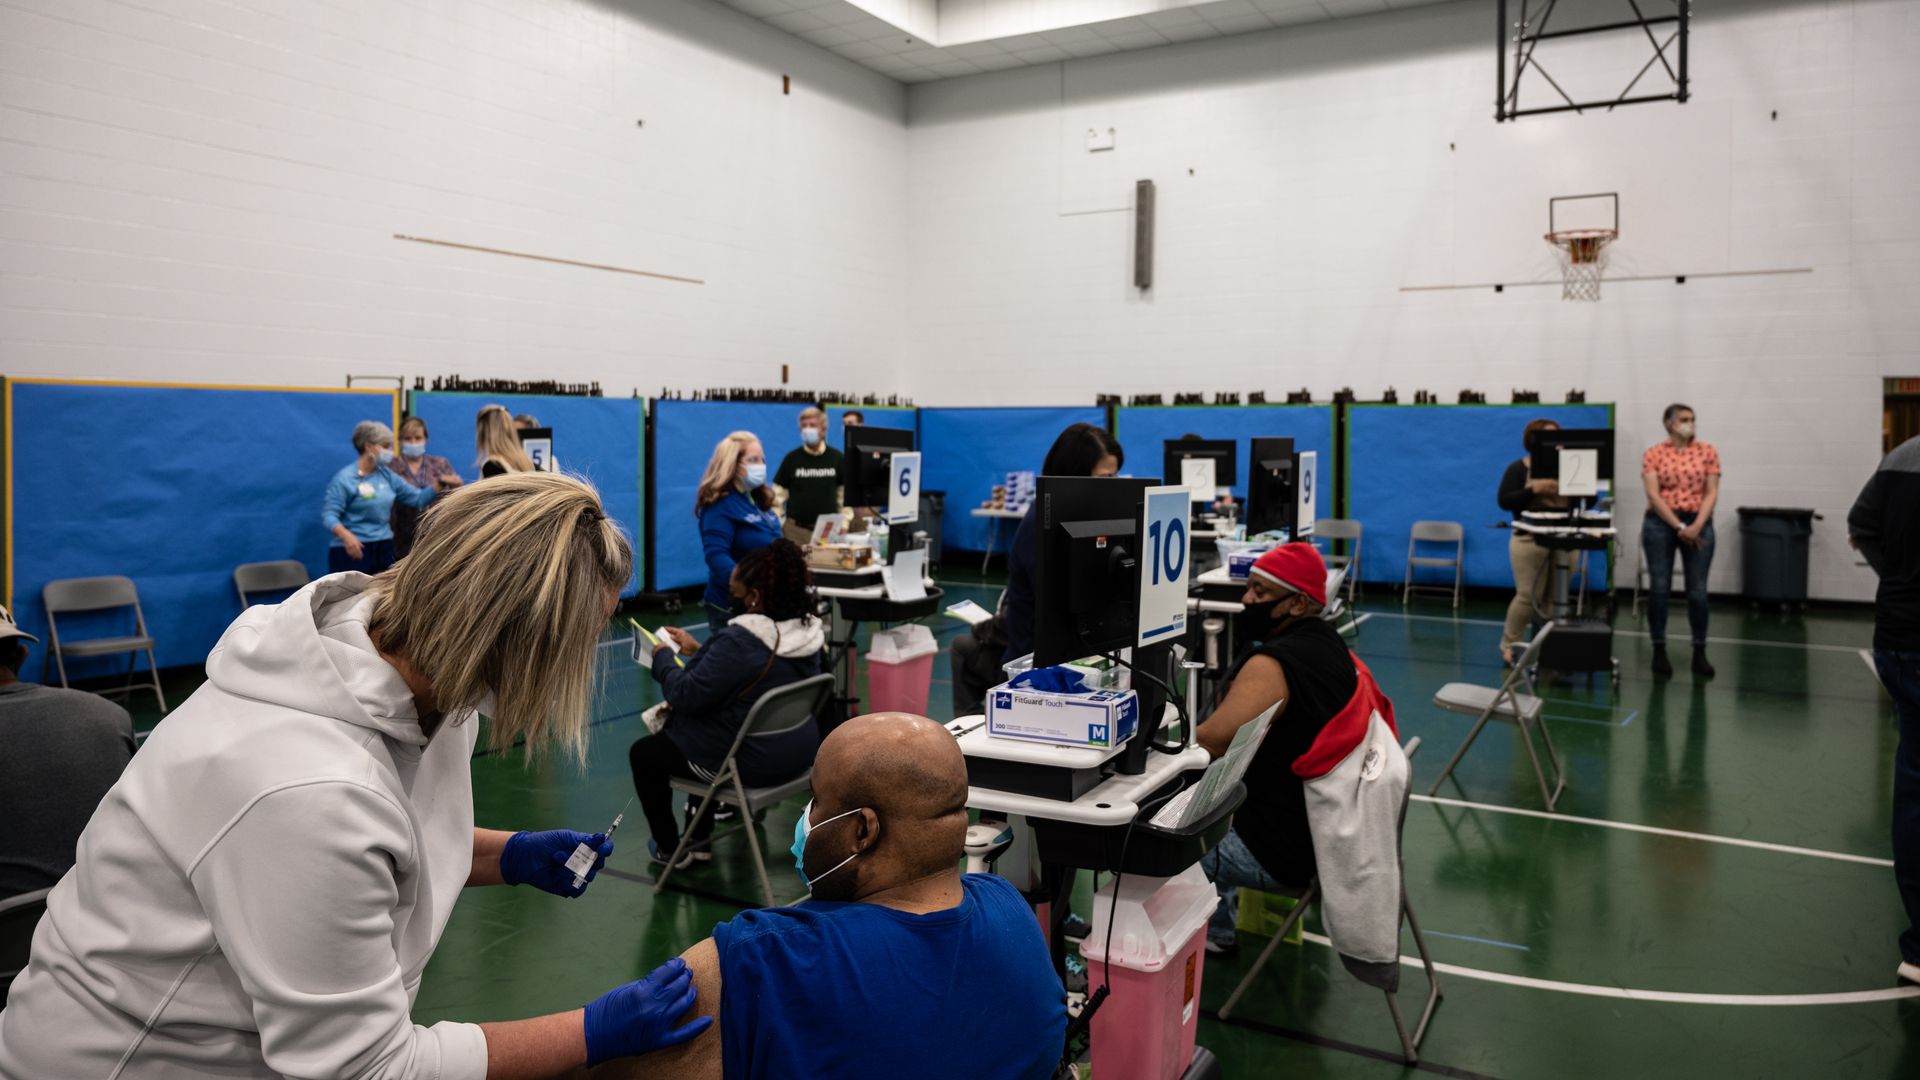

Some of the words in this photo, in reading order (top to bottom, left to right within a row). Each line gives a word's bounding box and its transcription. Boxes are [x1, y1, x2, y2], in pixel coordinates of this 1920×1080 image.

[533, 449, 542, 466] 5
[1567, 454, 1587, 487] 2
[899, 467, 911, 497] 6
[1190, 463, 1208, 489] 3
[1304, 470, 1312, 504] 9
[1149, 518, 1185, 585] 10
[1014, 697, 1043, 706] FitGuard
[1045, 699, 1063, 708] Touch
[1093, 727, 1105, 740] M
